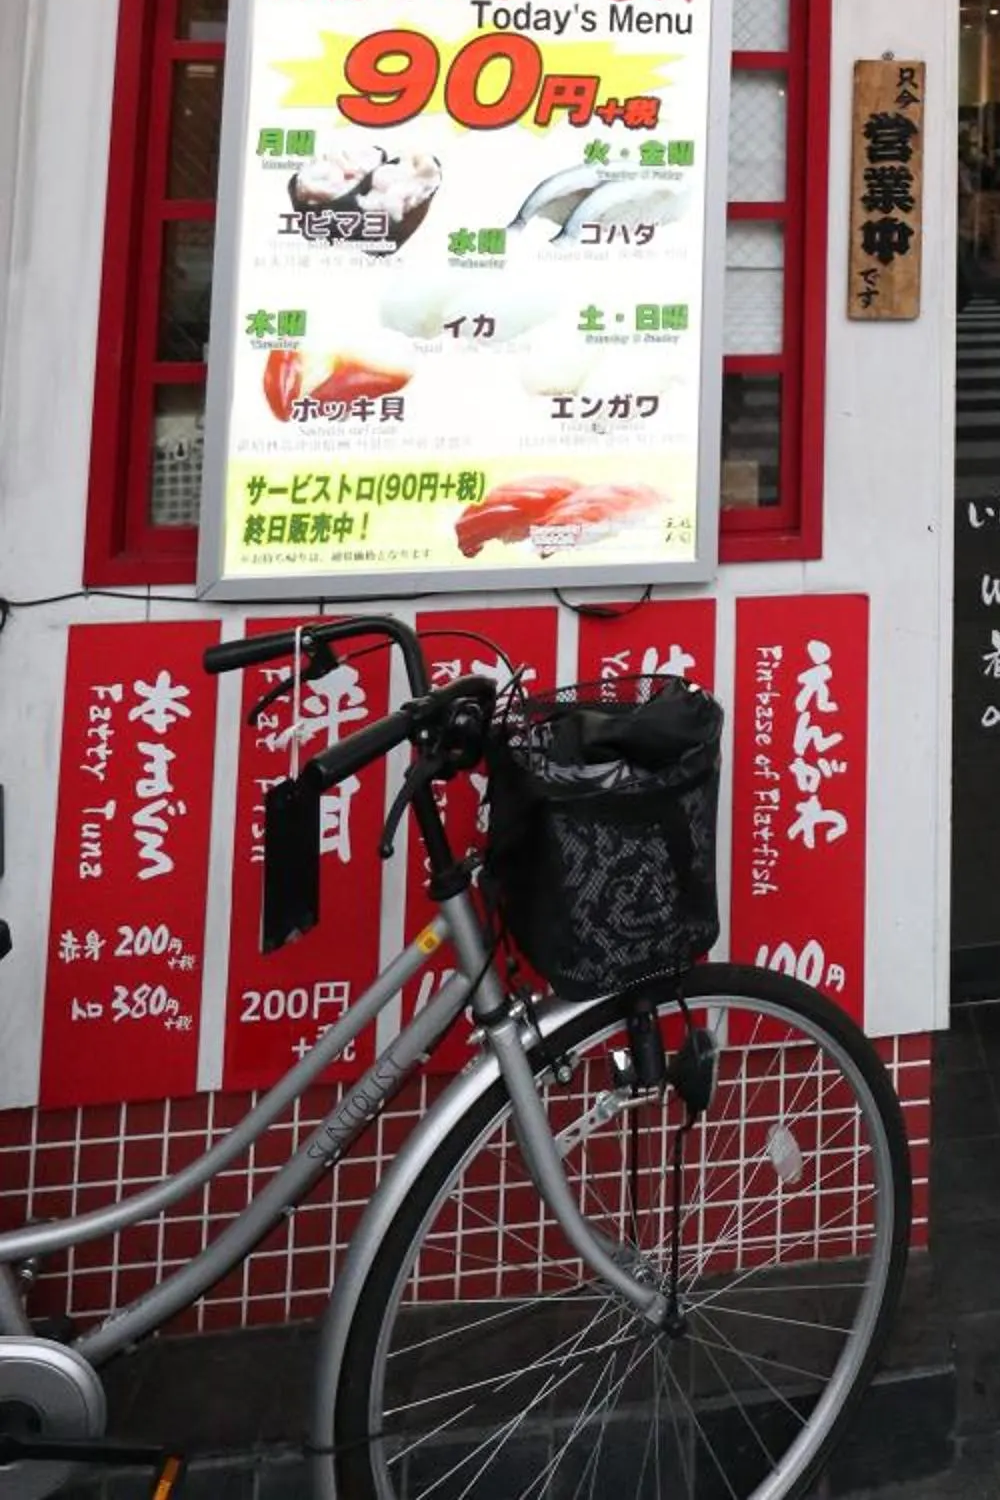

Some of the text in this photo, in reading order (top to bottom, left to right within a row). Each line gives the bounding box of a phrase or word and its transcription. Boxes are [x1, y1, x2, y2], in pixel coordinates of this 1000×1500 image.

[470, 0, 694, 35] Today's Menu
[256, 128, 315, 156] 月曜
[277, 210, 389, 237] エビマヨ
[581, 222, 659, 245] コハダ
[447, 227, 507, 255] 水曜
[245, 309, 307, 338] 木曜
[443, 314, 497, 338] イカ
[292, 397, 405, 422] ホッキ貝
[551, 393, 660, 419] エンガワ
[753, 644, 784, 746] Fin-base
[788, 639, 849, 849] えんがわ
[79, 682, 124, 880] Fatty Tuna
[129, 669, 192, 881] 本まぐろ
[753, 755, 780, 783] of
[58, 929, 107, 964] 赤身
[71, 997, 103, 1022] トロ
[240, 981, 350, 1023] 200円
